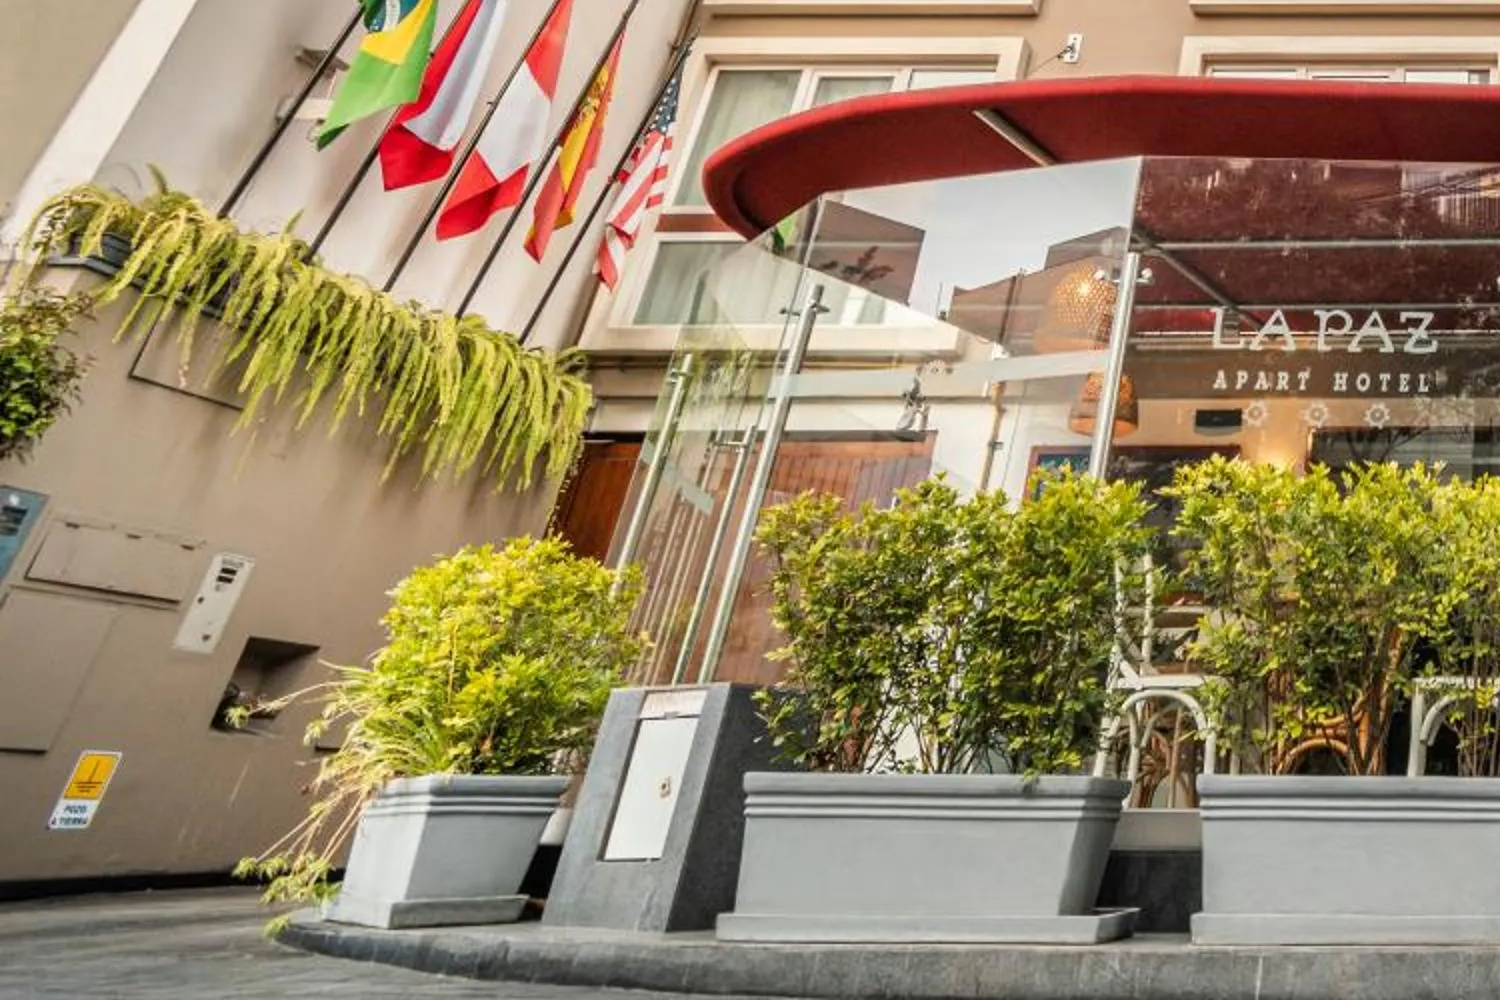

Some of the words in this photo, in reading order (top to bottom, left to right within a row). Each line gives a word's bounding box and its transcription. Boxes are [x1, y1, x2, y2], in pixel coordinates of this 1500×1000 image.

[1210, 307, 1297, 352] LA
[1313, 309, 1438, 354] PAZ
[1212, 369, 1310, 391] APART
[1333, 371, 1429, 393] HOTEL
